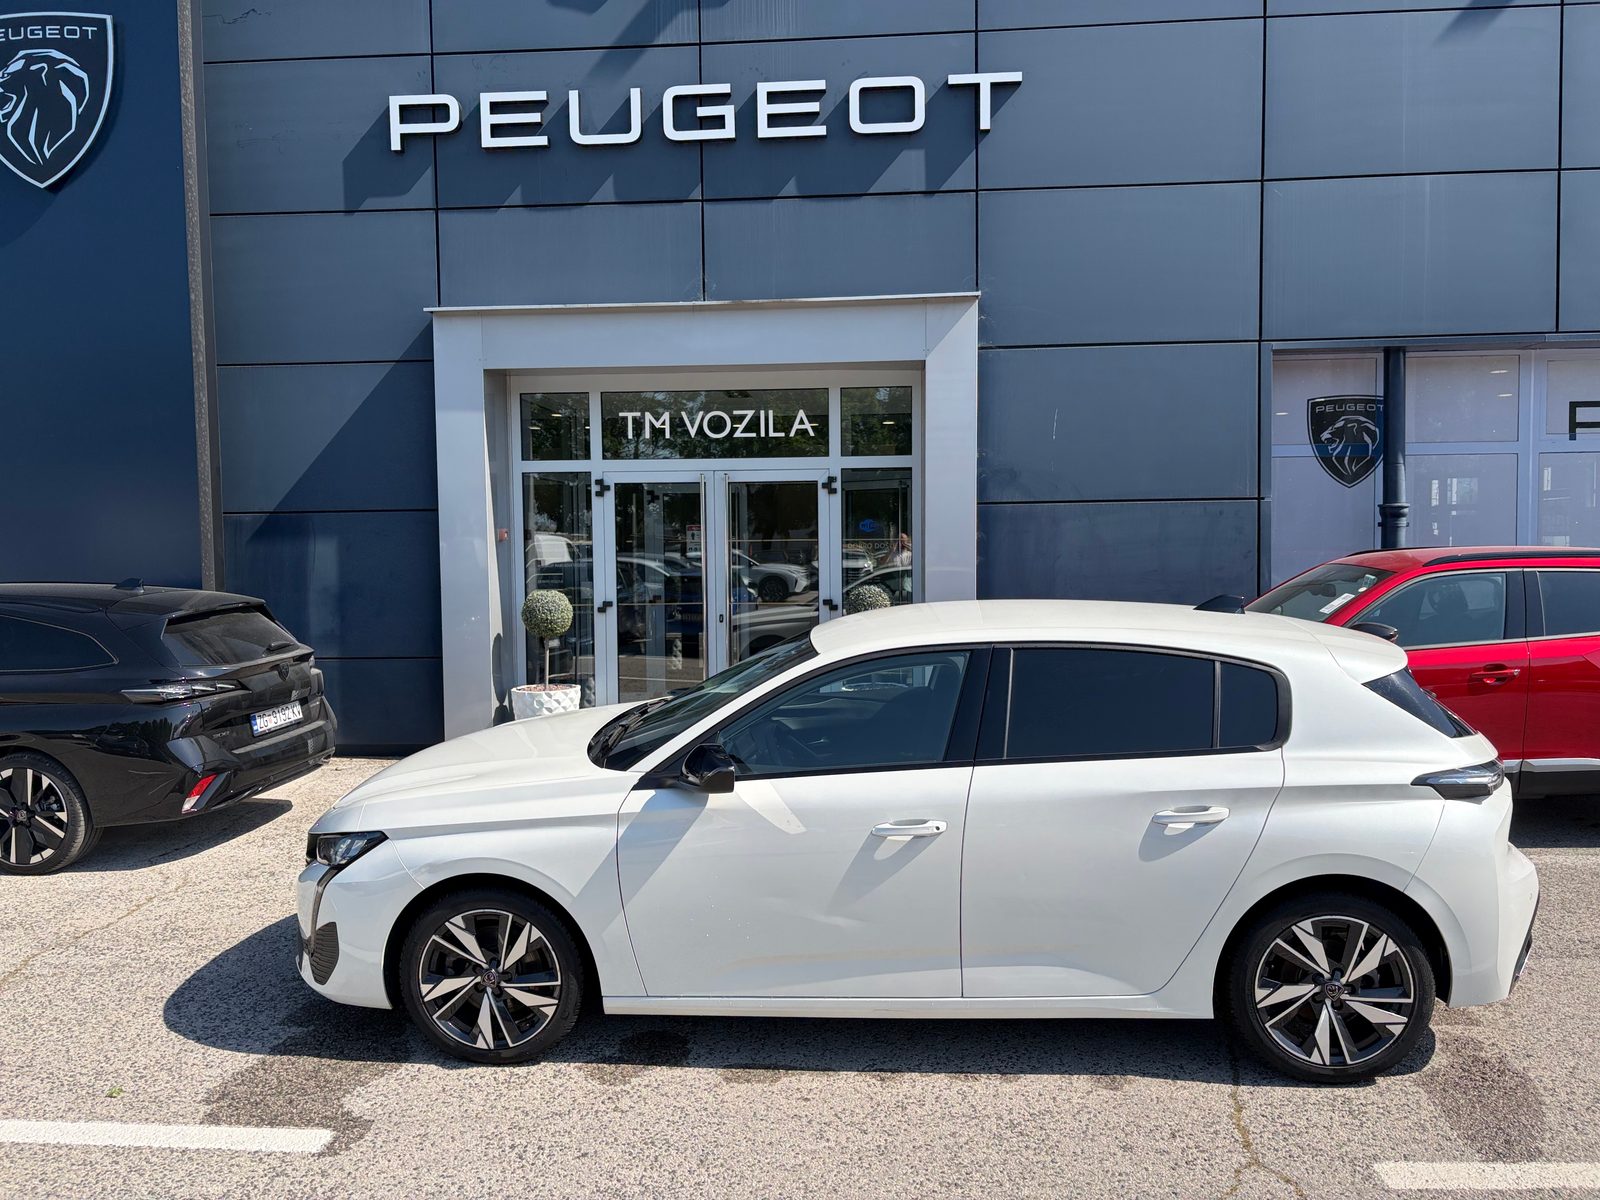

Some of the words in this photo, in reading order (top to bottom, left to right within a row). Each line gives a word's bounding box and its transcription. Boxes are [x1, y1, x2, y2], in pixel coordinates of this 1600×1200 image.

[388, 71, 1023, 151] PEUGEOT
[1315, 403, 1384, 414] PEUGEOT
[618, 411, 671, 439] TM
[680, 409, 816, 439] VOZILA
